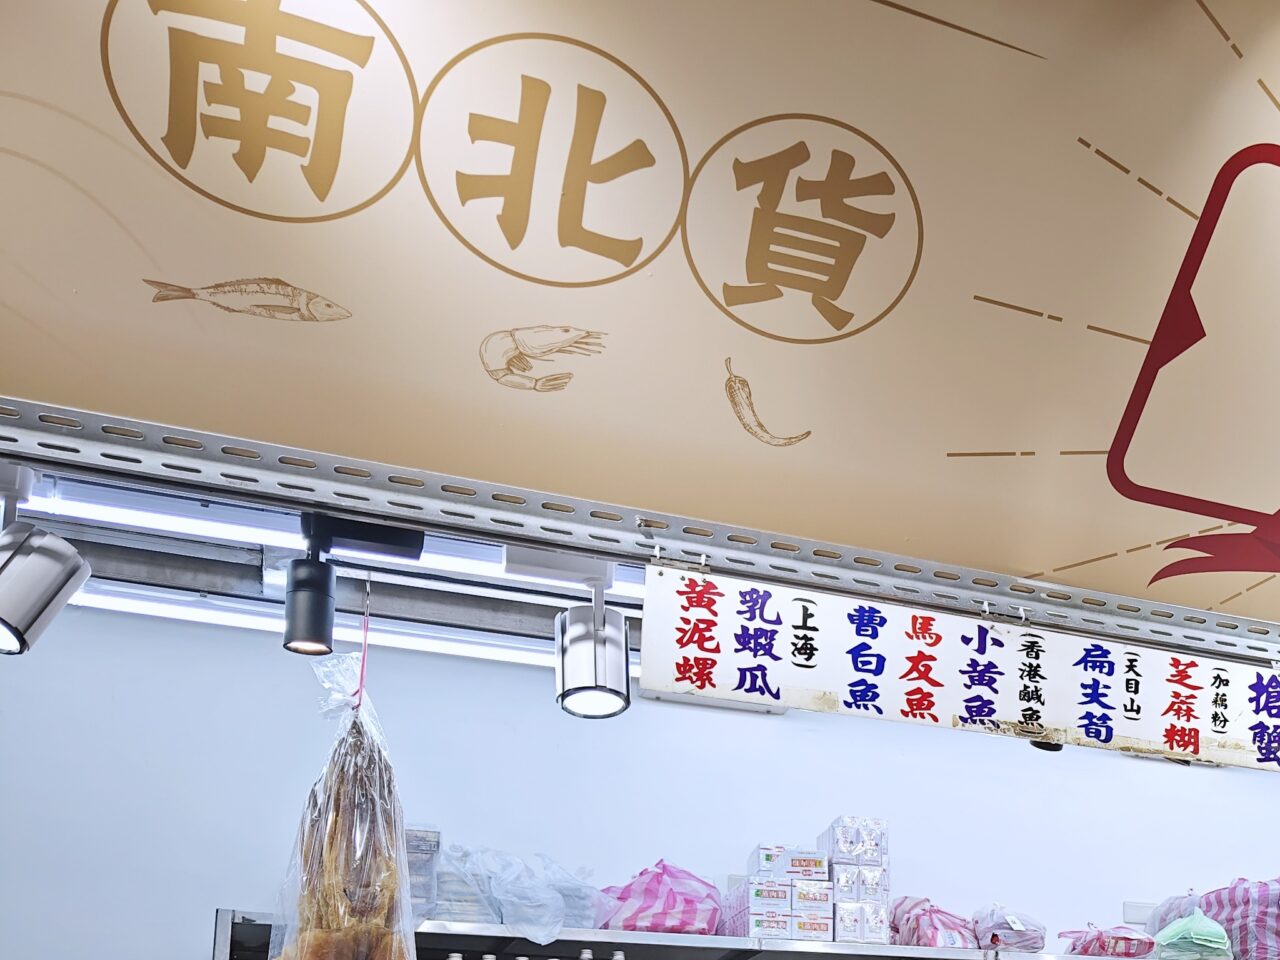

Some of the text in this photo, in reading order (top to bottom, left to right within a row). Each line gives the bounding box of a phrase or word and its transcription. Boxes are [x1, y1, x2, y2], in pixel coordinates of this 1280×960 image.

[147, 0, 896, 331] 南北貨
[843, 605, 887, 715] 曹白魚
[899, 614, 944, 723] 馬友魚
[958, 624, 1005, 730] 小黃魚
[1161, 657, 1204, 755] 芝麻糊
